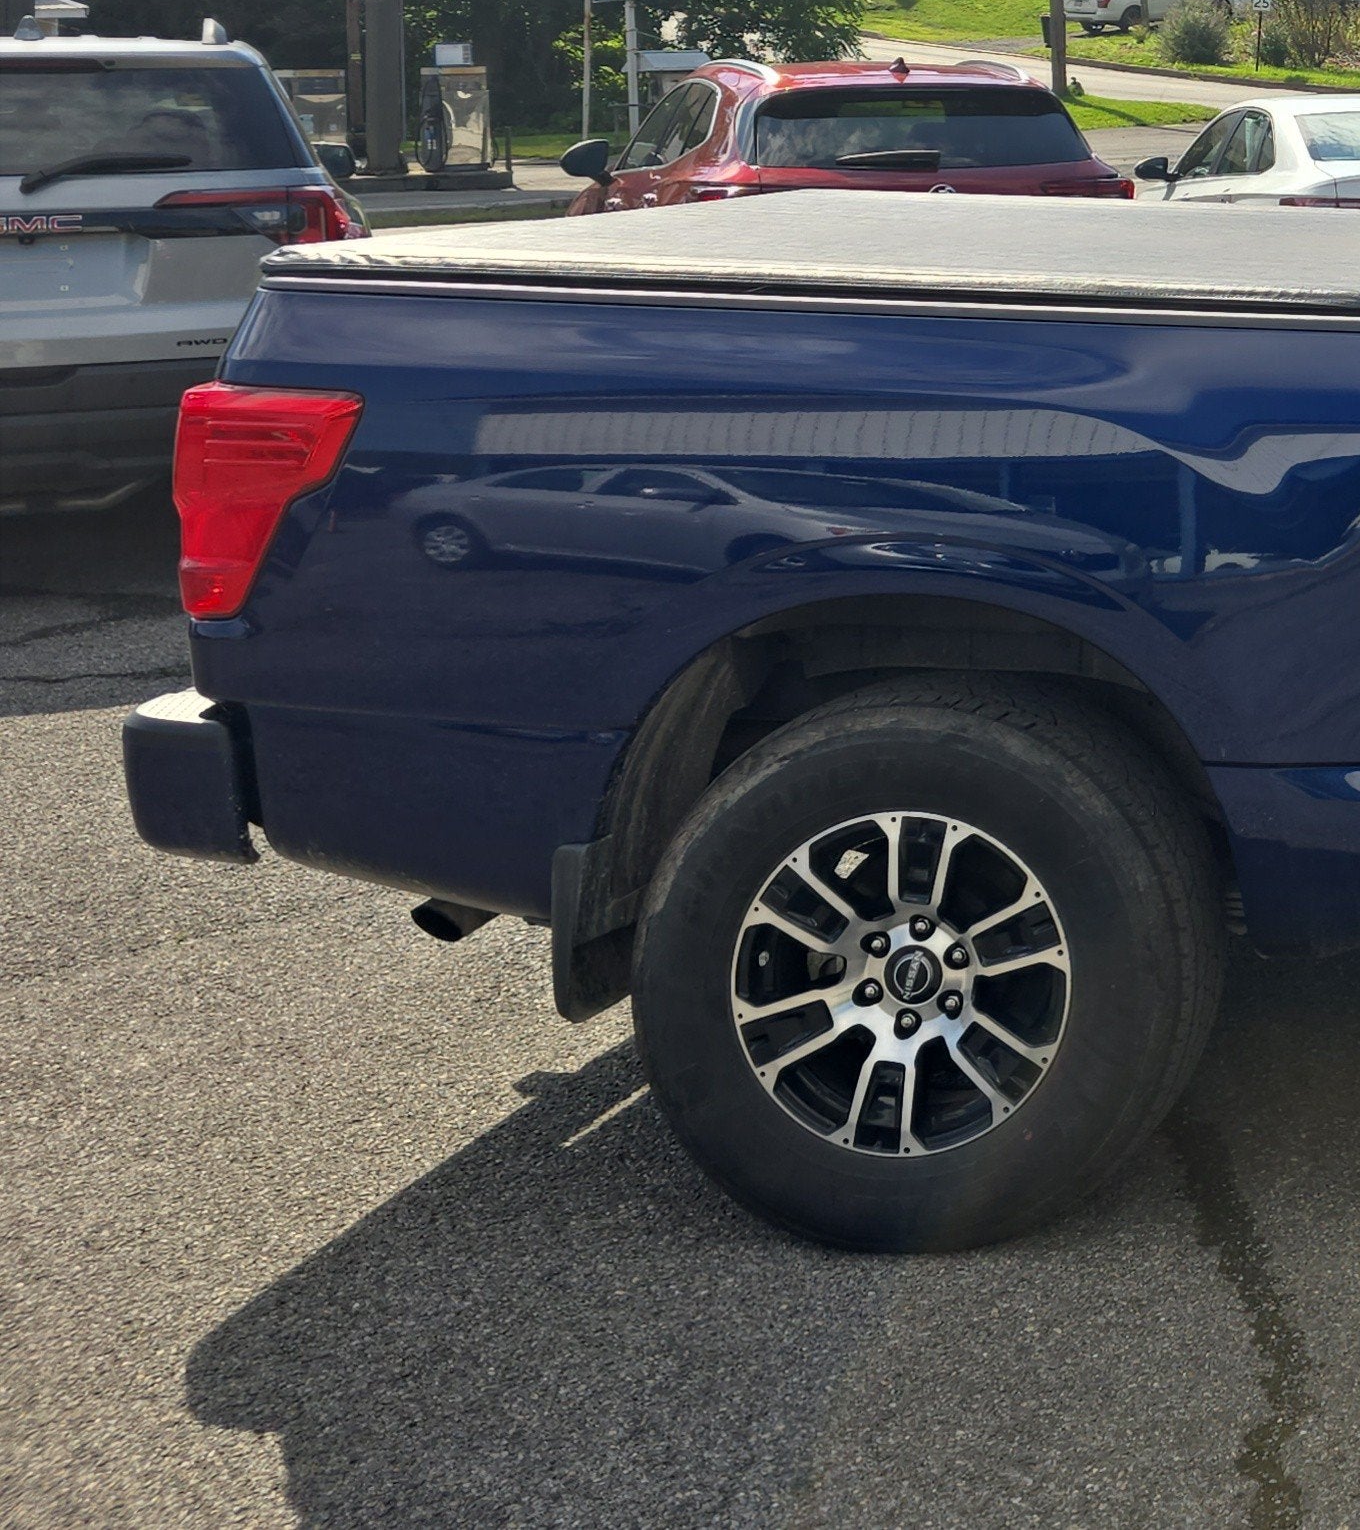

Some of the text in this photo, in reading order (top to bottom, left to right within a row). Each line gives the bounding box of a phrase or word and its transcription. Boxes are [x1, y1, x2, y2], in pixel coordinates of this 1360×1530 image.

[0, 215, 82, 233] MC
[176, 337, 228, 346] AWD
[903, 950, 924, 1000] NISSAN
